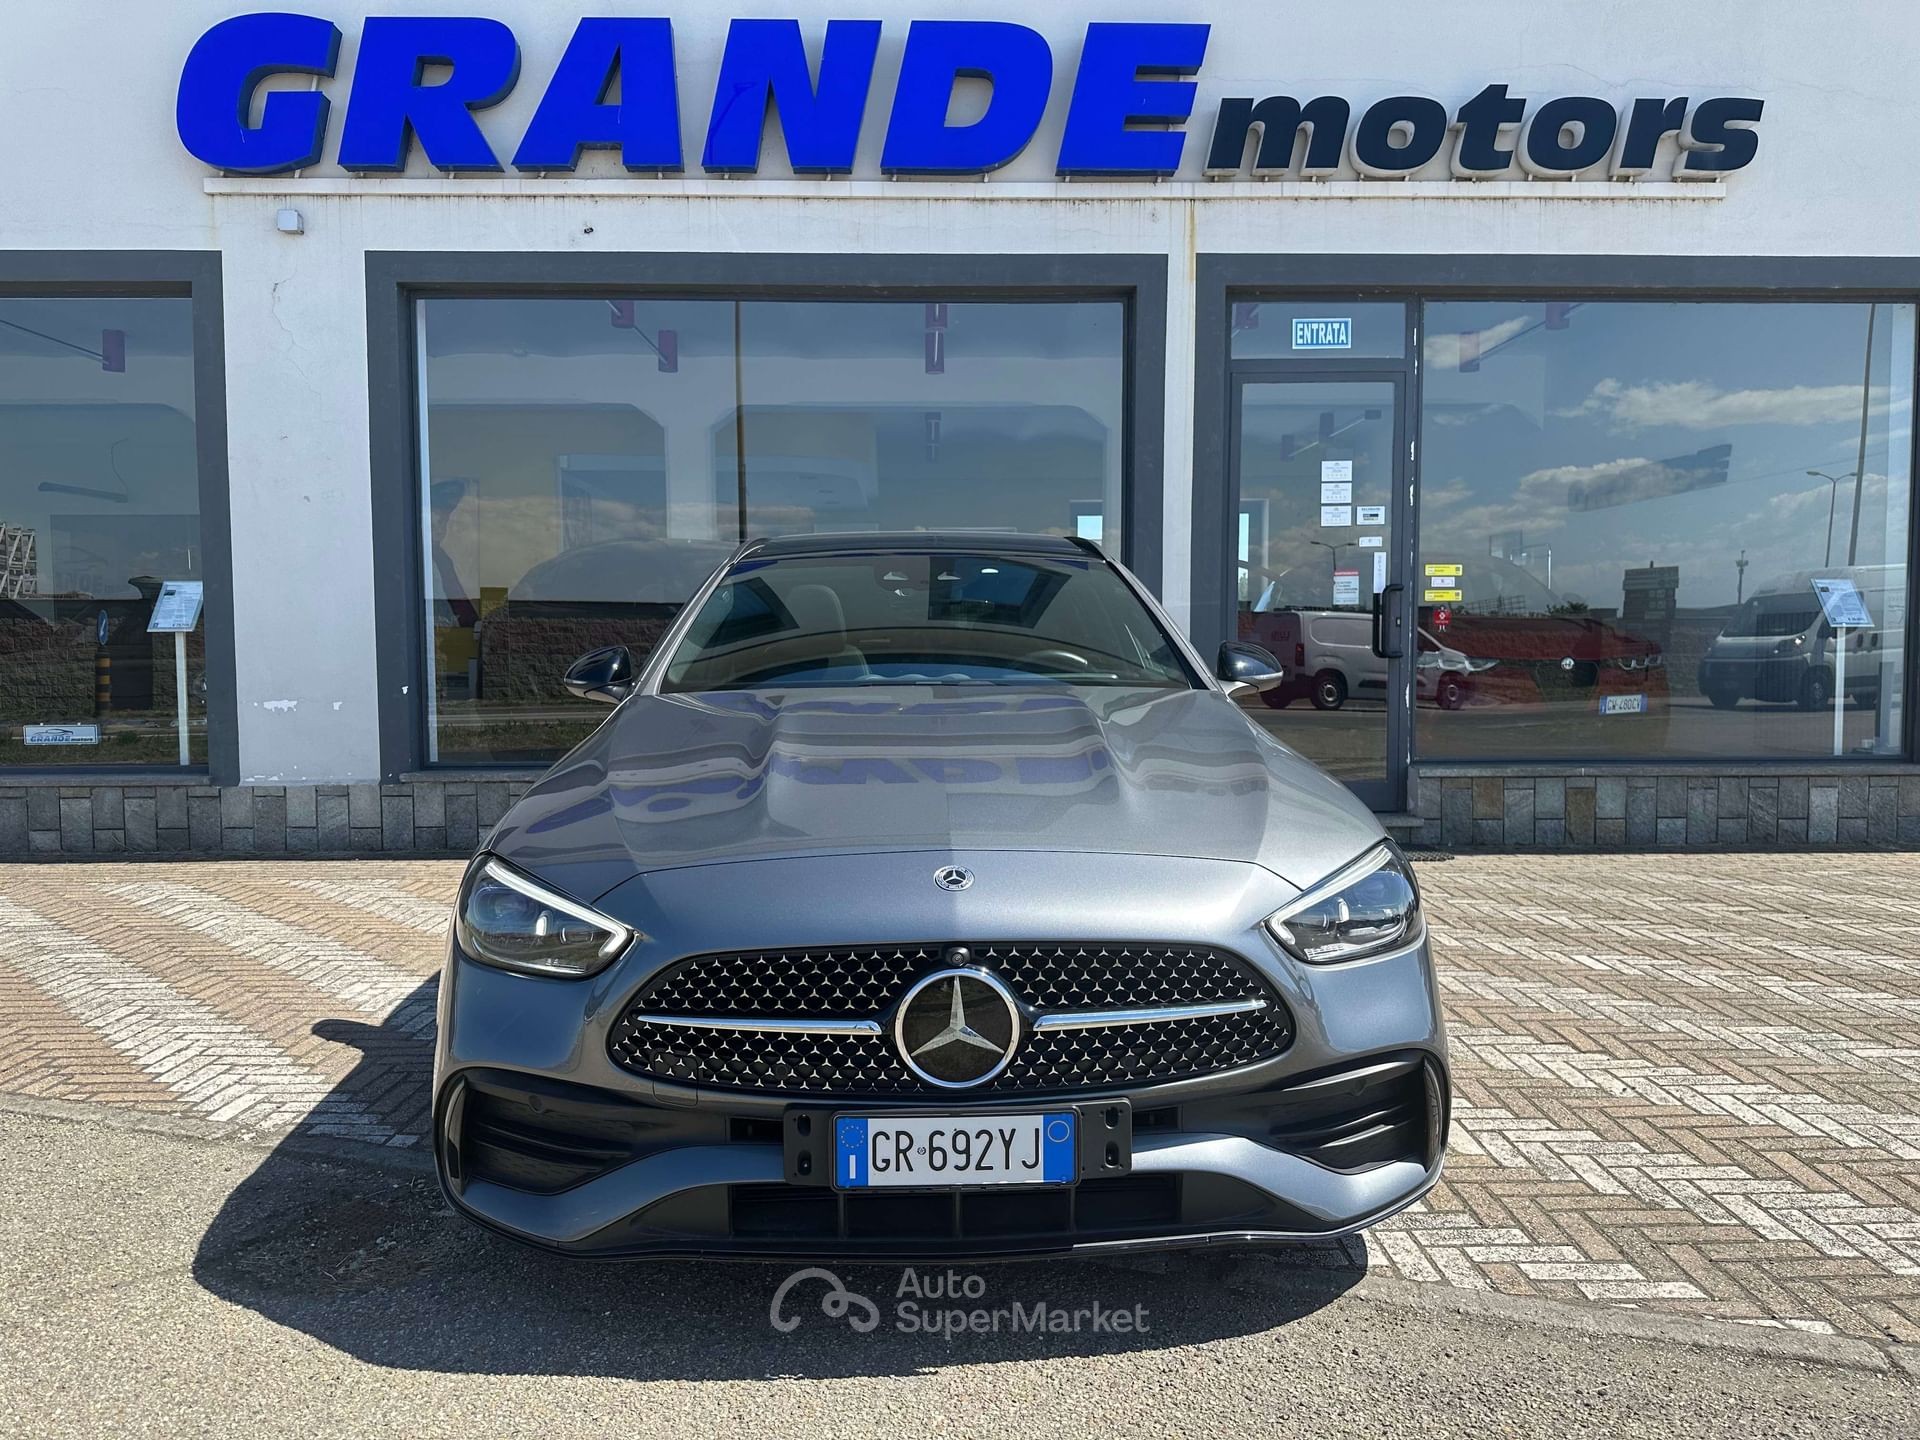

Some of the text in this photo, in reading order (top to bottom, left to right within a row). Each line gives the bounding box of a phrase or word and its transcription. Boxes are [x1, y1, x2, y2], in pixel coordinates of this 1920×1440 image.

[175, 11, 1765, 175] GRANDE motors
[1296, 322, 1347, 345] ENTRATA
[31, 735, 70, 743] GRANDE
